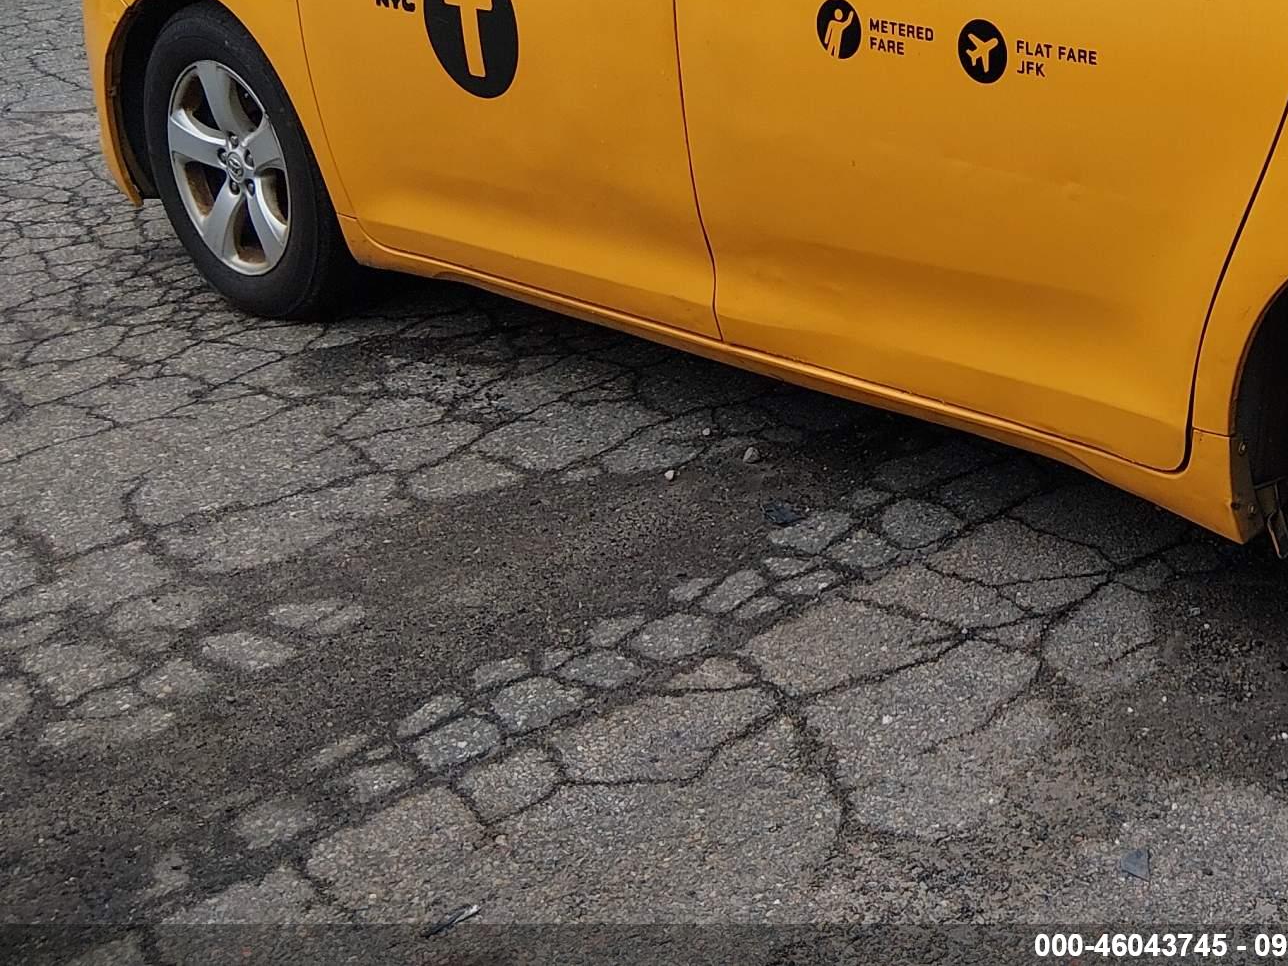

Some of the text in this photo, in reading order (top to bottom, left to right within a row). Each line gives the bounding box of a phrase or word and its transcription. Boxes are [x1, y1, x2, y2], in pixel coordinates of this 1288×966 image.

[869, 17, 934, 42] METERED
[869, 36, 905, 56] FARE
[1016, 40, 1098, 66] FLAT FARE
[1016, 60, 1046, 78] JFK
